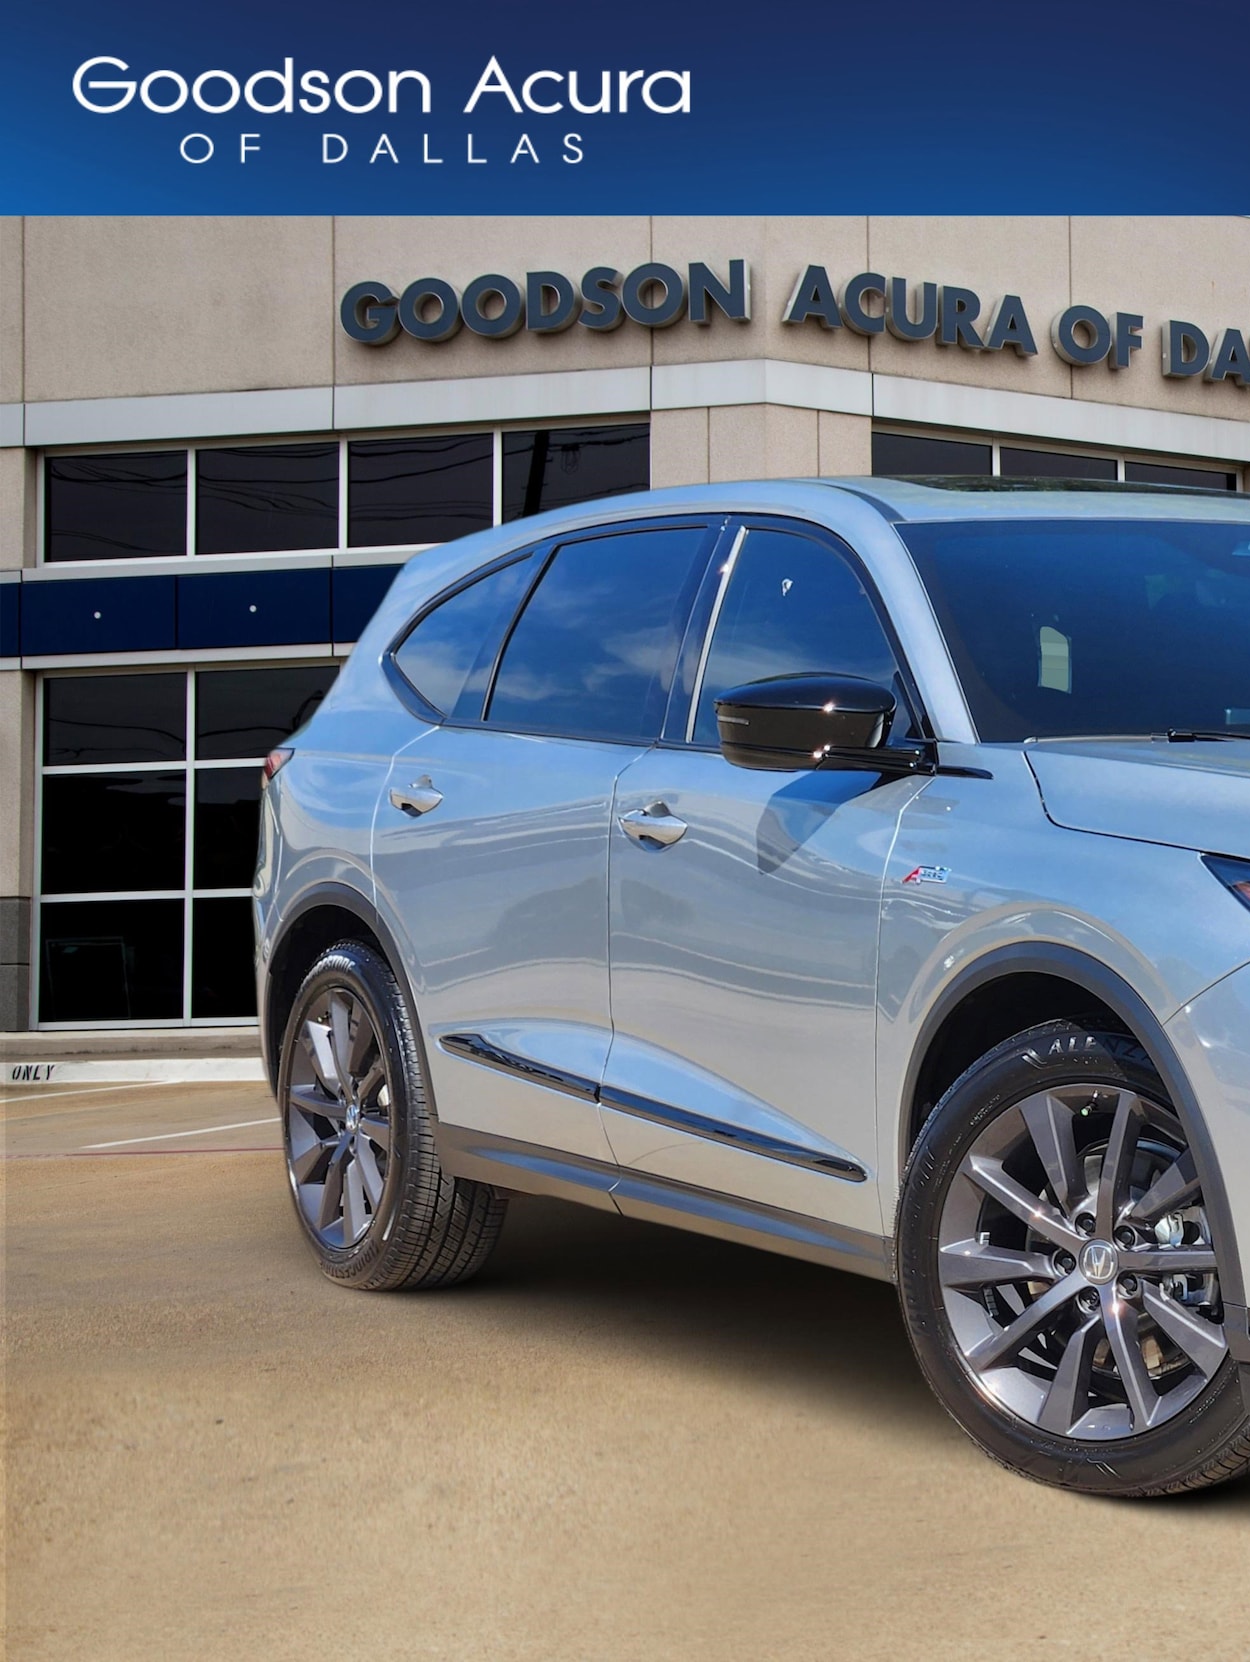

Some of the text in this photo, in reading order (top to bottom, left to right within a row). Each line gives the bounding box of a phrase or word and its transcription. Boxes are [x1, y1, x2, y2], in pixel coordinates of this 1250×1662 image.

[340, 259, 750, 346] GOODSON
[782, 264, 1038, 358] ACURA
[1050, 305, 1143, 370] OF
[12, 1064, 55, 1081] ONLY
